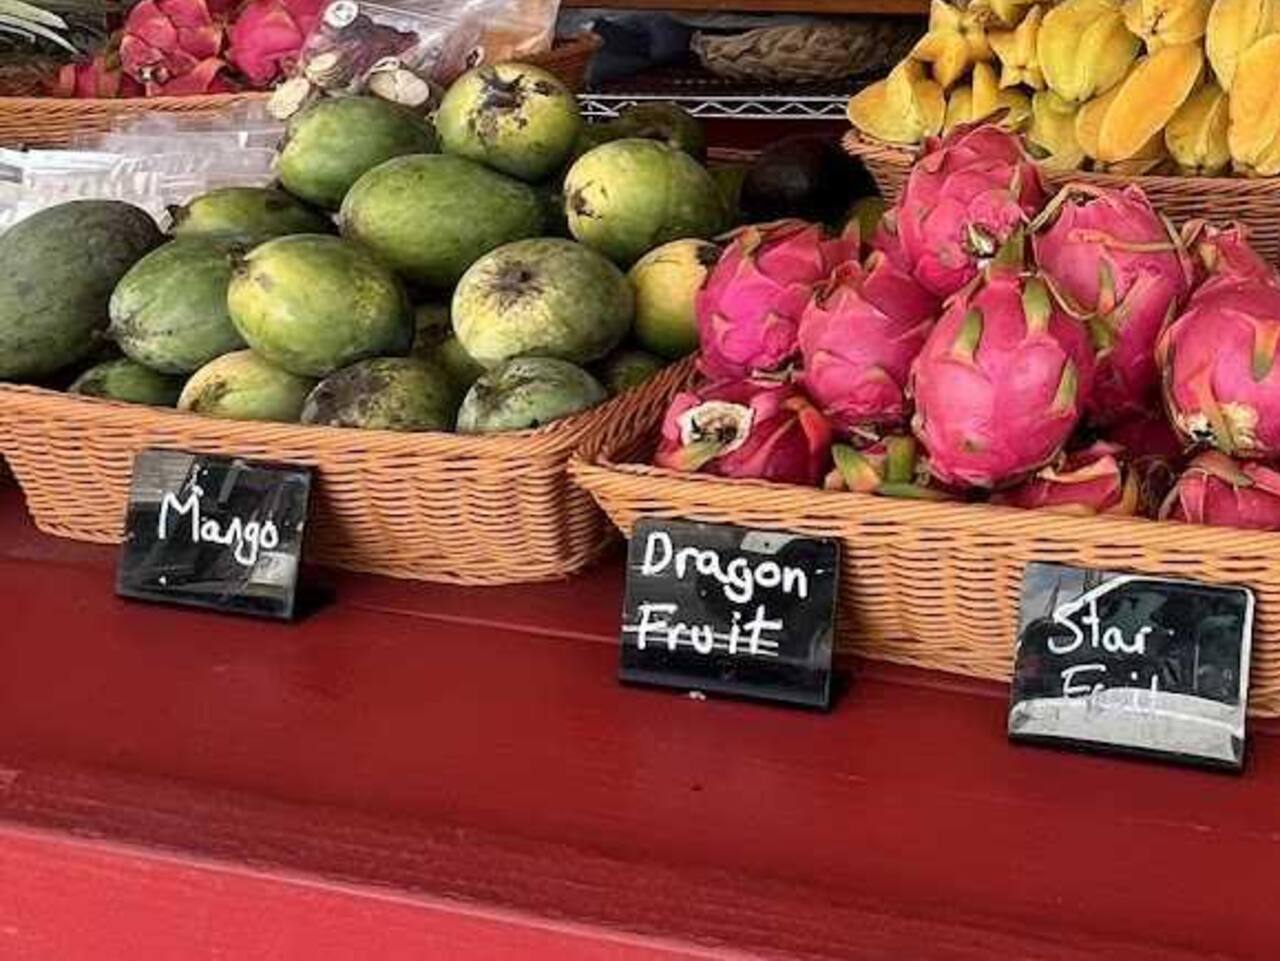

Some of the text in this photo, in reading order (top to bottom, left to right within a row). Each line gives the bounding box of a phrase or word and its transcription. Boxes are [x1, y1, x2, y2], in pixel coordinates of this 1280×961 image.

[158, 490, 279, 566] Mango
[641, 530, 809, 604] Dragon
[636, 604, 783, 655] Fruit
[1048, 596, 1153, 655] Star
